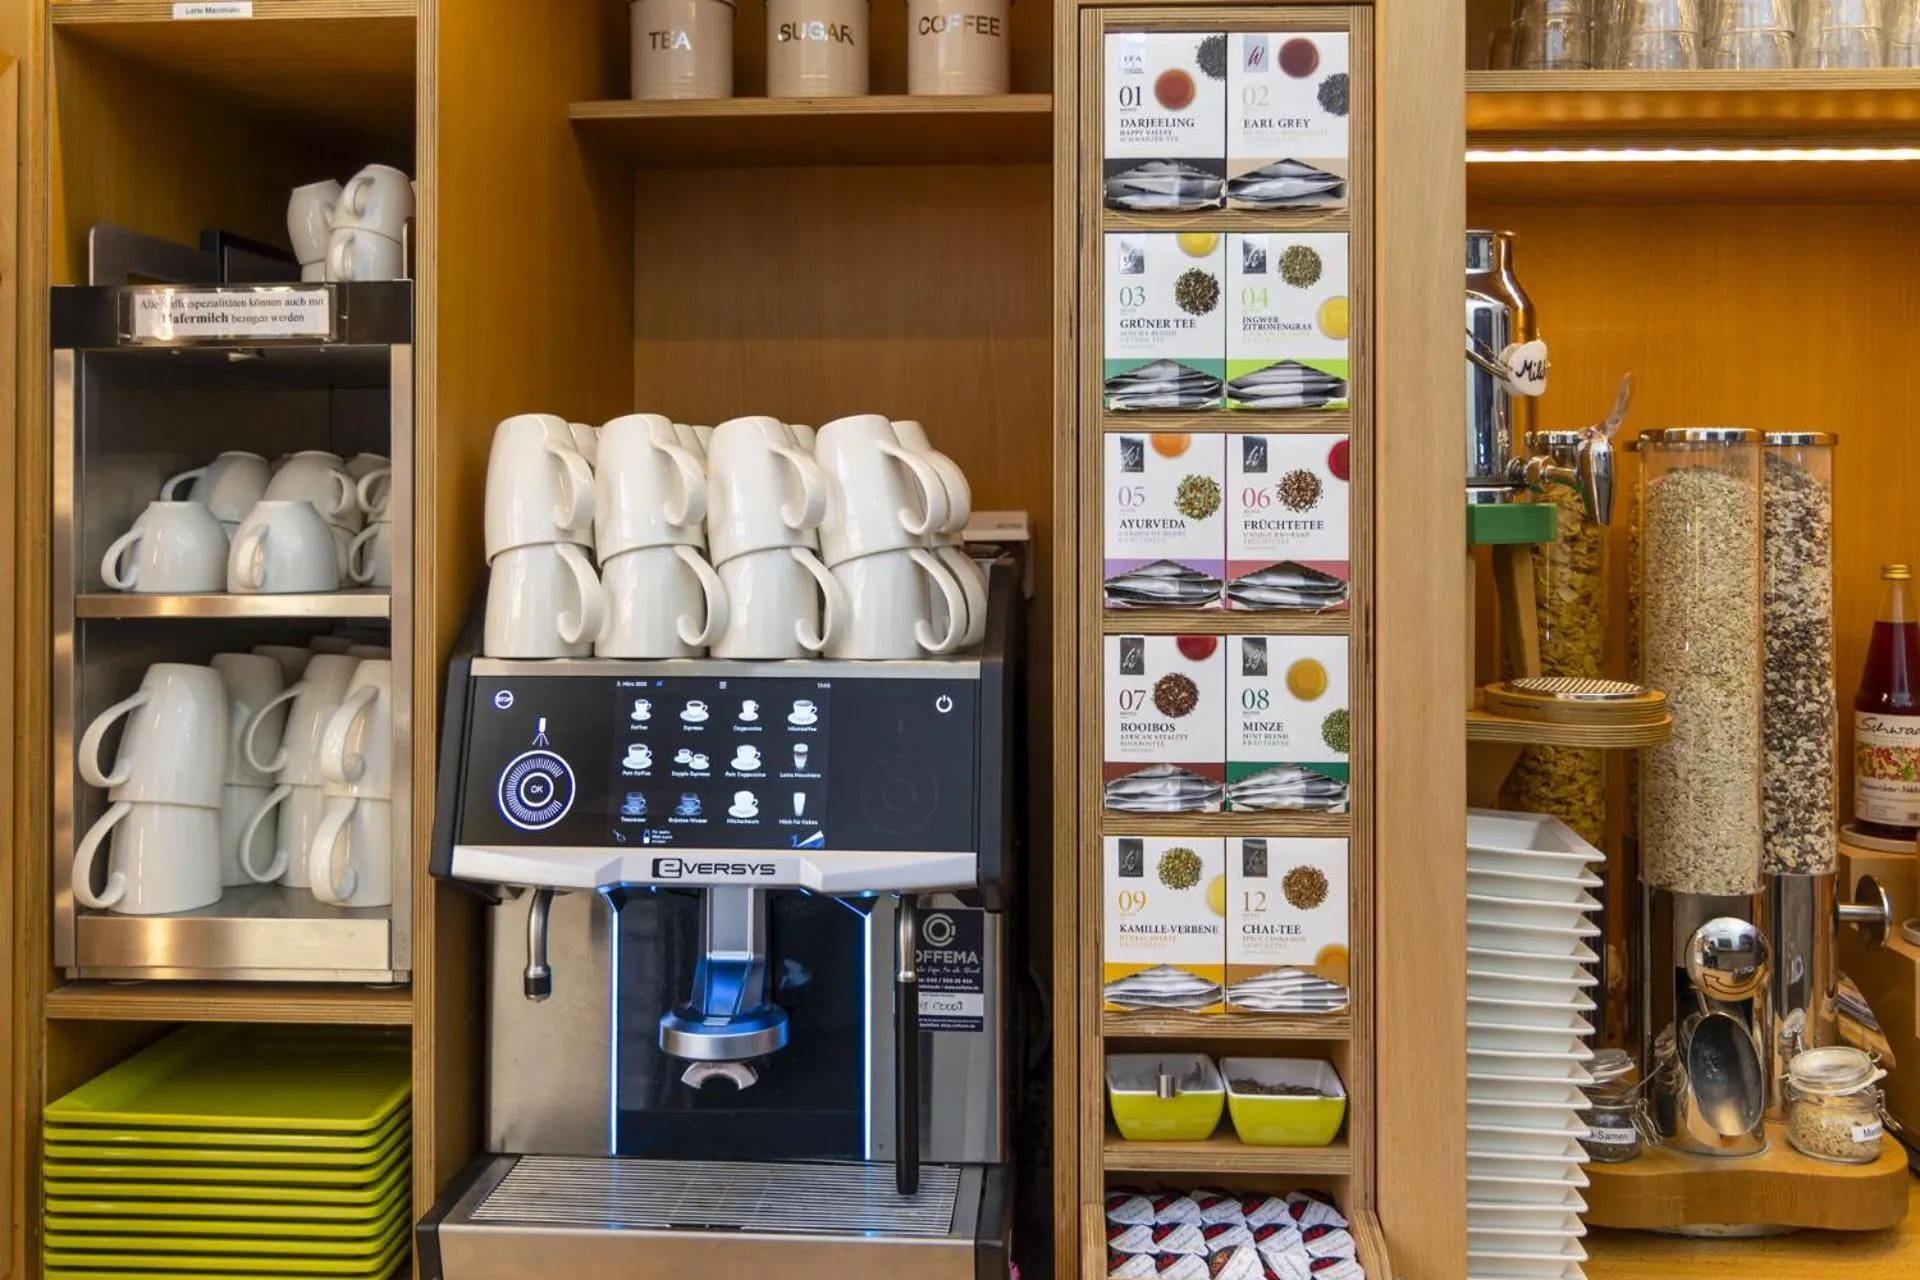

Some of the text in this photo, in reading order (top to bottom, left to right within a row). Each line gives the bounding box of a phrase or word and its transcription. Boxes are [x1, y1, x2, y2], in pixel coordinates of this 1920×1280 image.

[918, 14, 1001, 37] COFFEE
[649, 31, 691, 50] TEA
[777, 22, 854, 46] SUGAR
[1119, 86, 1142, 107] 01
[1242, 85, 1269, 107] 02
[1120, 118, 1195, 128] DARJEELING
[1243, 118, 1311, 128] EARL GREY
[162, 298, 246, 309] affespezialitäten
[249, 298, 283, 307] können
[285, 297, 306, 306] auch
[309, 297, 324, 306] mit
[1119, 286, 1146, 308] 03
[1241, 287, 1269, 309] 04
[231, 314, 268, 326] bezogen
[271, 314, 304, 323] werden
[1120, 317, 1197, 329] GRÜNER TEE
[1242, 323, 1313, 331] ZITRONENGRAS
[1118, 486, 1145, 507] 05
[1242, 486, 1271, 509] 06
[1120, 519, 1186, 529] AYURVEDA
[1243, 519, 1325, 530] FRÜCHTETEE
[1119, 689, 1147, 711] 07
[1242, 688, 1270, 710] 08
[1120, 722, 1176, 732] ROOIBOS
[1242, 721, 1284, 731] MINZE
[531, 785, 544, 793] OK
[1118, 890, 1147, 912] 09
[1243, 891, 1267, 912] 12
[1120, 924, 1219, 934] KAMILLE-VERBENE
[1242, 924, 1302, 934] CHAI-TEE
[916, 950, 979, 964] OFFEMA
